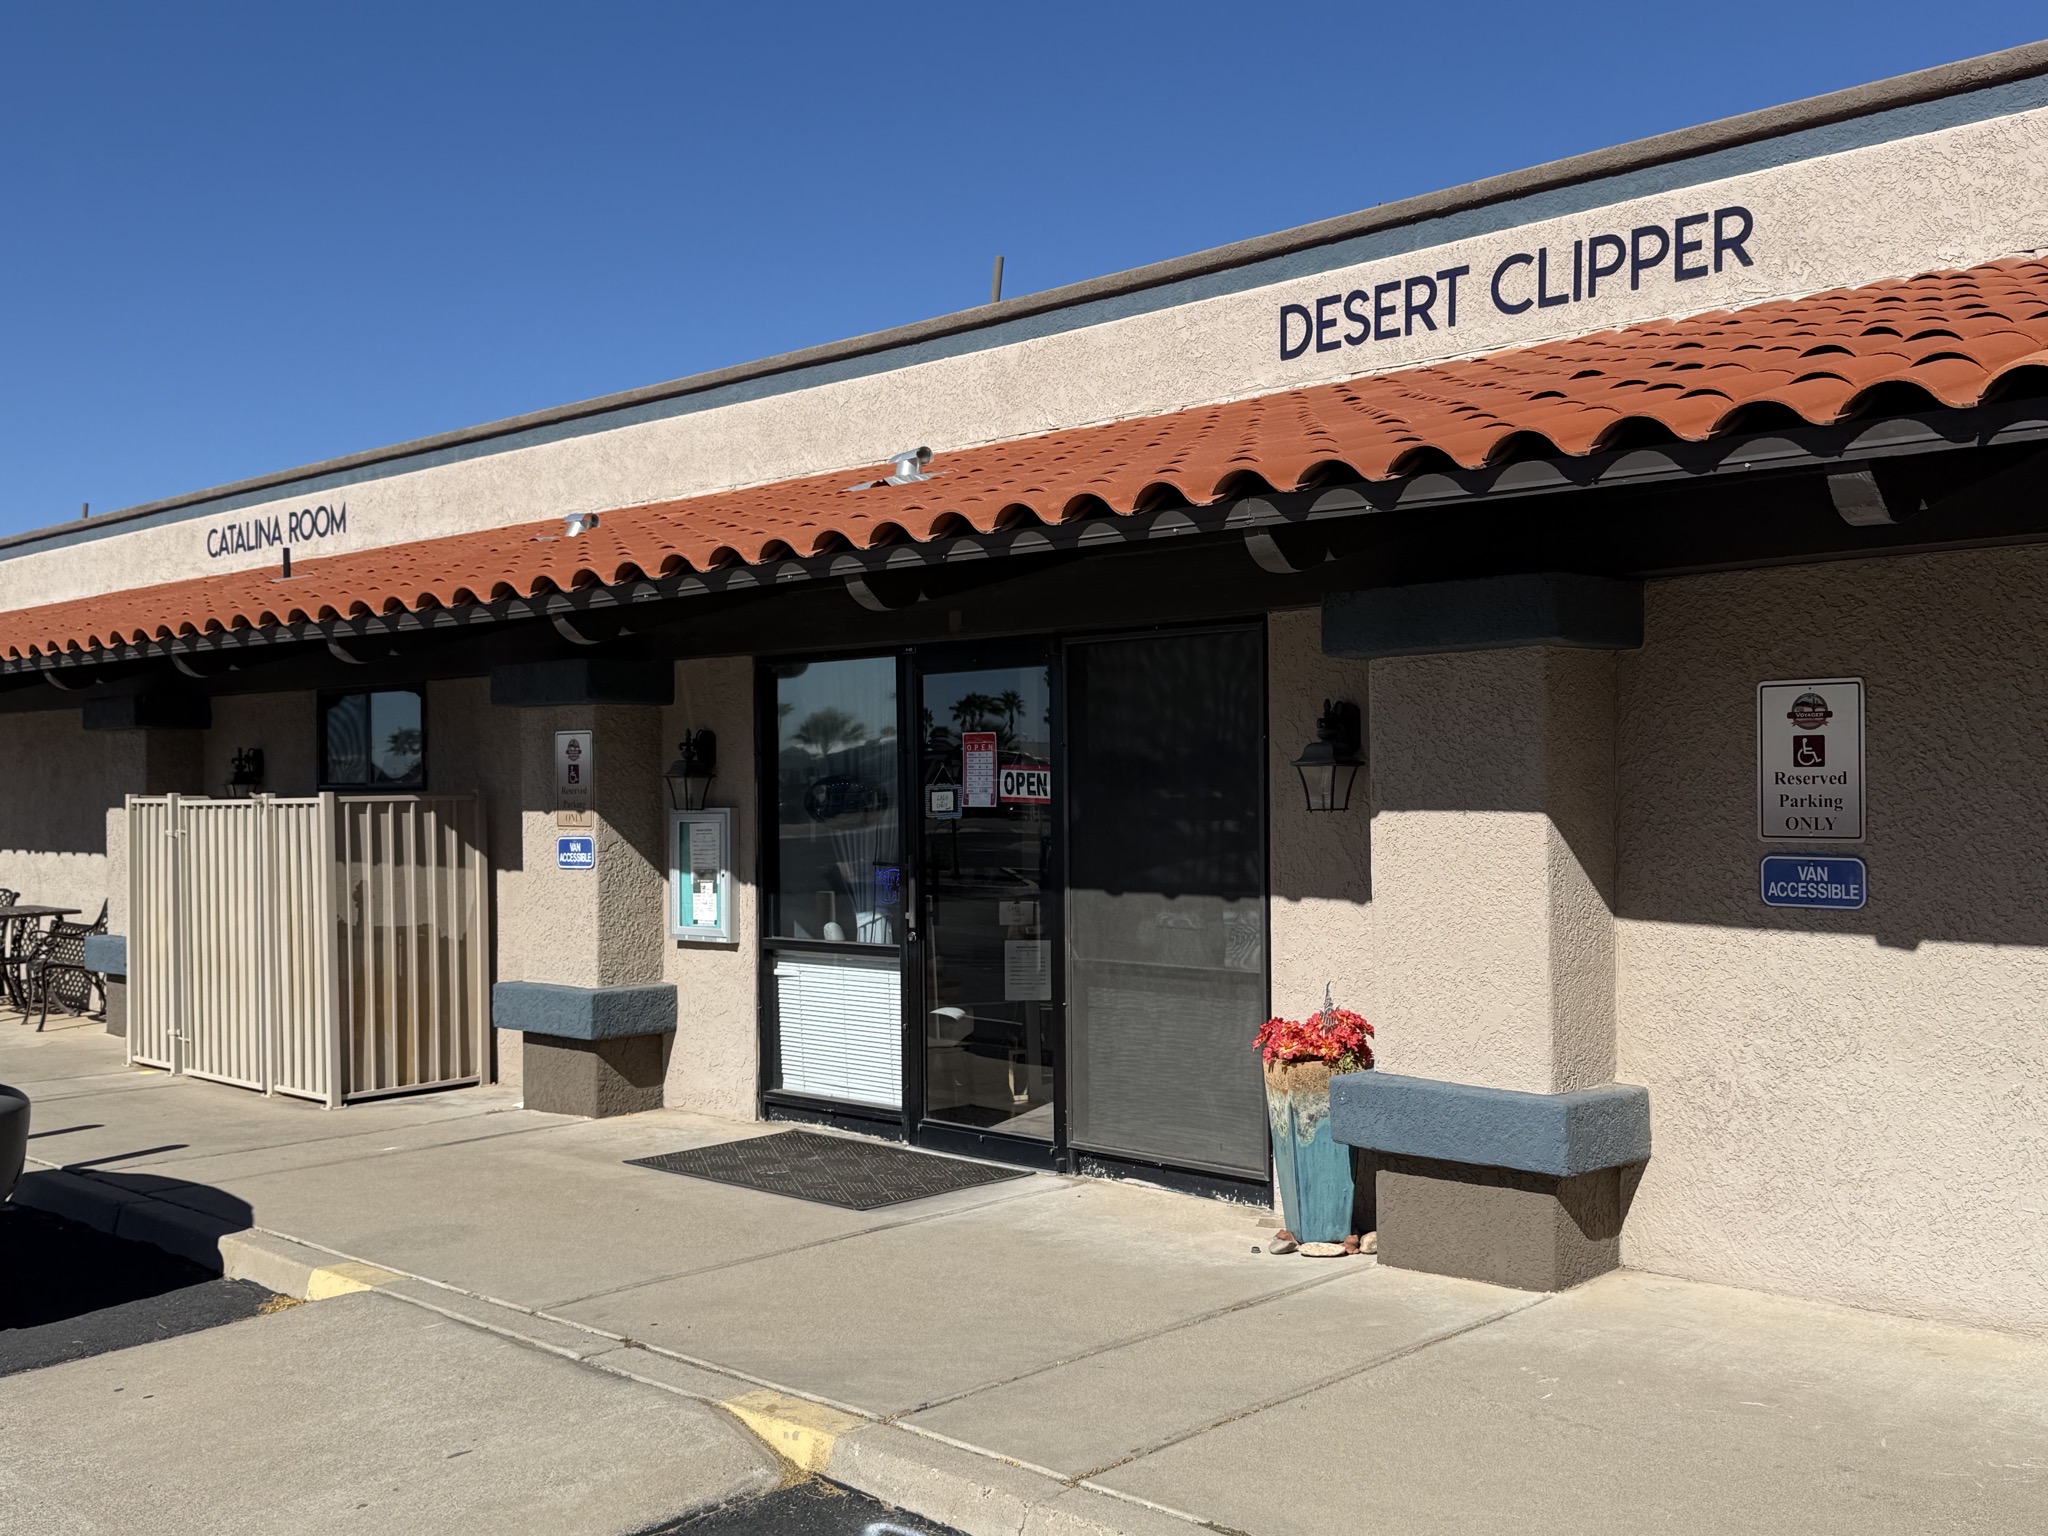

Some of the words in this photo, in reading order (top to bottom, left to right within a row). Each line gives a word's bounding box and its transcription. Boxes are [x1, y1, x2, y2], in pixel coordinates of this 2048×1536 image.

[1280, 264, 1470, 361] DESERT
[1490, 205, 1754, 316] CLIPPER
[207, 515, 284, 558] CATALINA
[289, 501, 347, 543] ROOM
[966, 743, 994, 752] OPEN
[1003, 771, 1048, 797] OPEN
[1774, 771, 1848, 785] Reserved
[561, 786, 588, 795] Reserved
[563, 800, 586, 810] Parking
[1779, 794, 1843, 811] Parking
[565, 813, 584, 823] ONLY
[1785, 816, 1838, 831] ONLY
[569, 842, 581, 852] VAN
[559, 851, 592, 863] ACCESSIBLE
[1797, 865, 1829, 882] VAN
[1767, 881, 1860, 900] ACCESSIBLE
